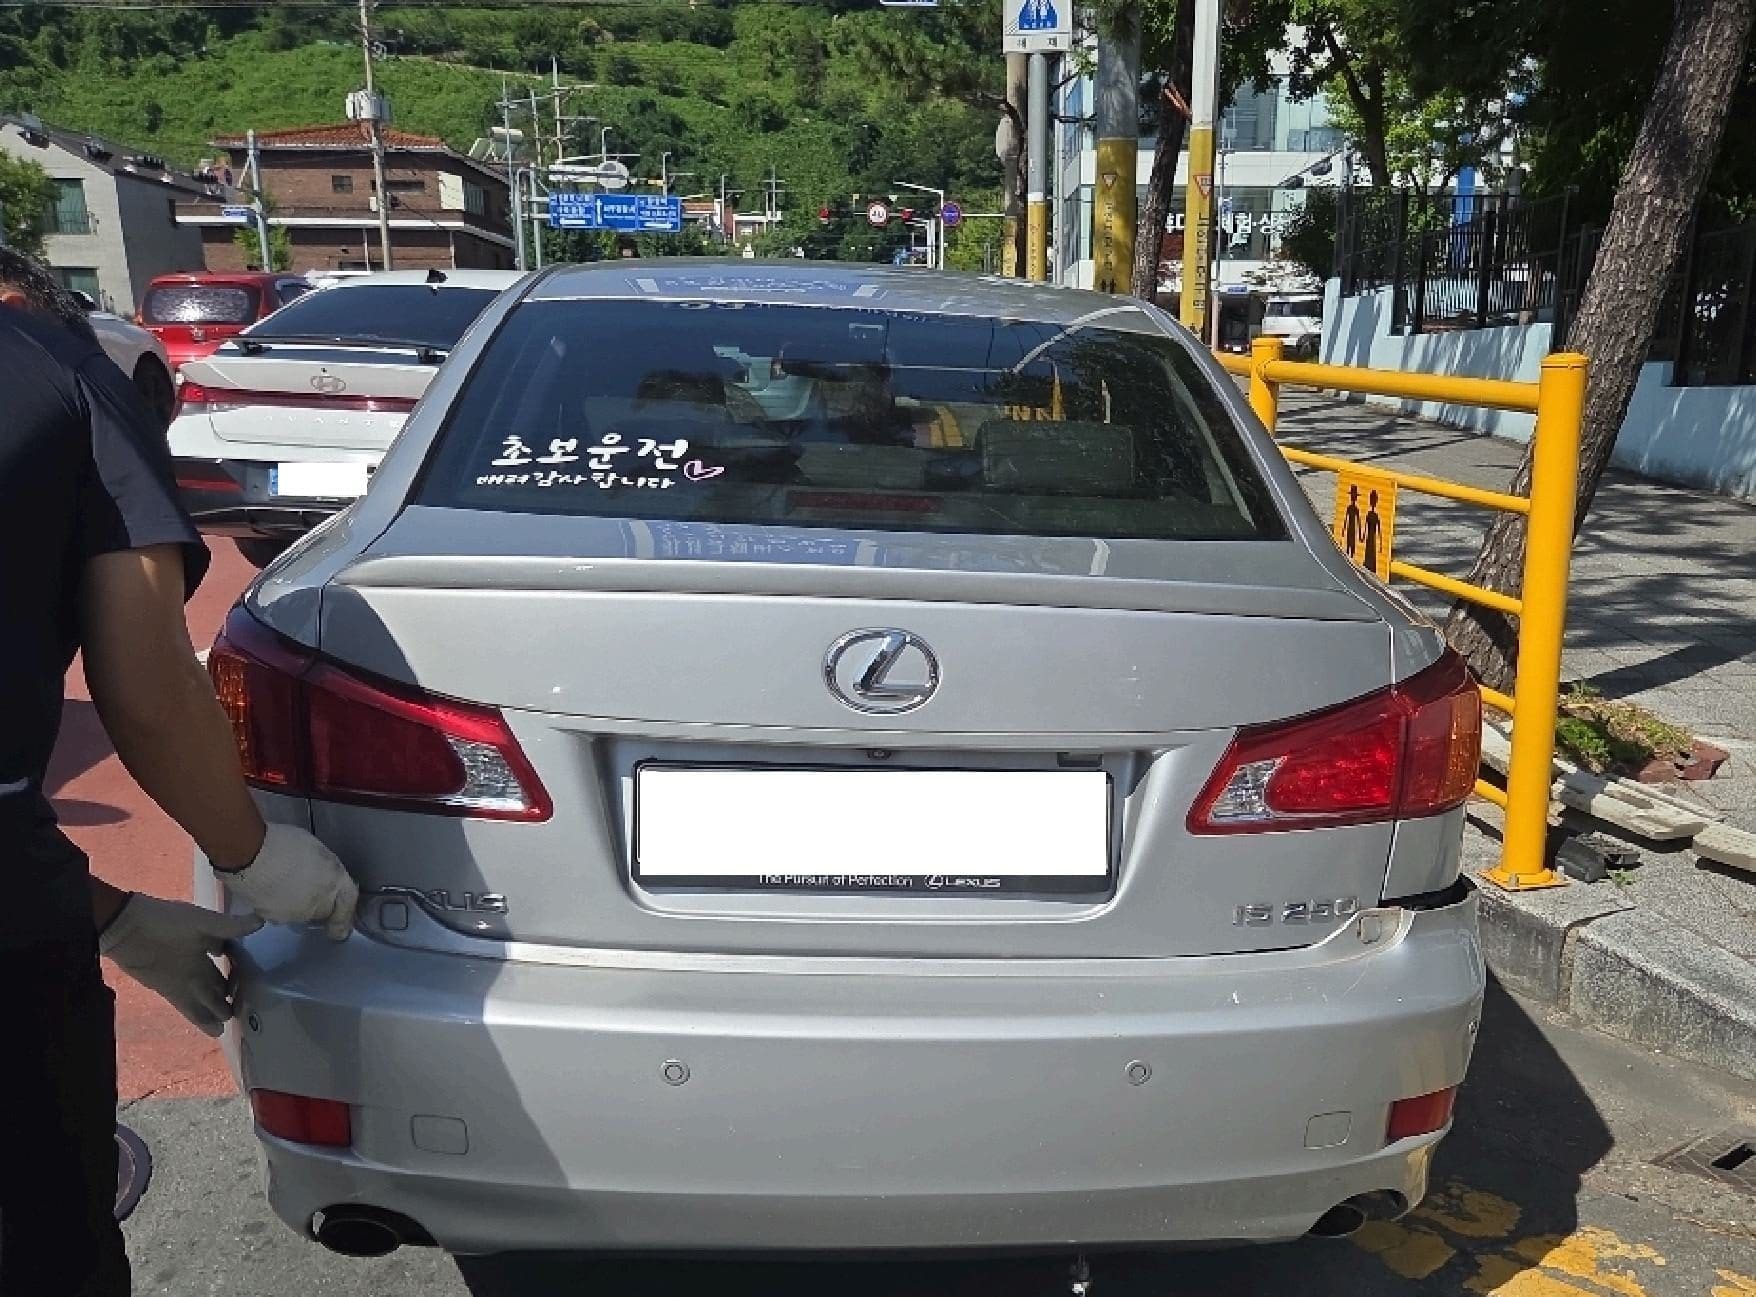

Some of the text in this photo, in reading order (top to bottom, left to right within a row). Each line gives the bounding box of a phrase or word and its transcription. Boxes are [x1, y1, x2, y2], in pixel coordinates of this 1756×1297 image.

[491, 432, 689, 470] 초보운전
[784, 875, 829, 886] Pursuit
[849, 875, 913, 888] Perfection
[1232, 896, 1360, 927] IS 250
